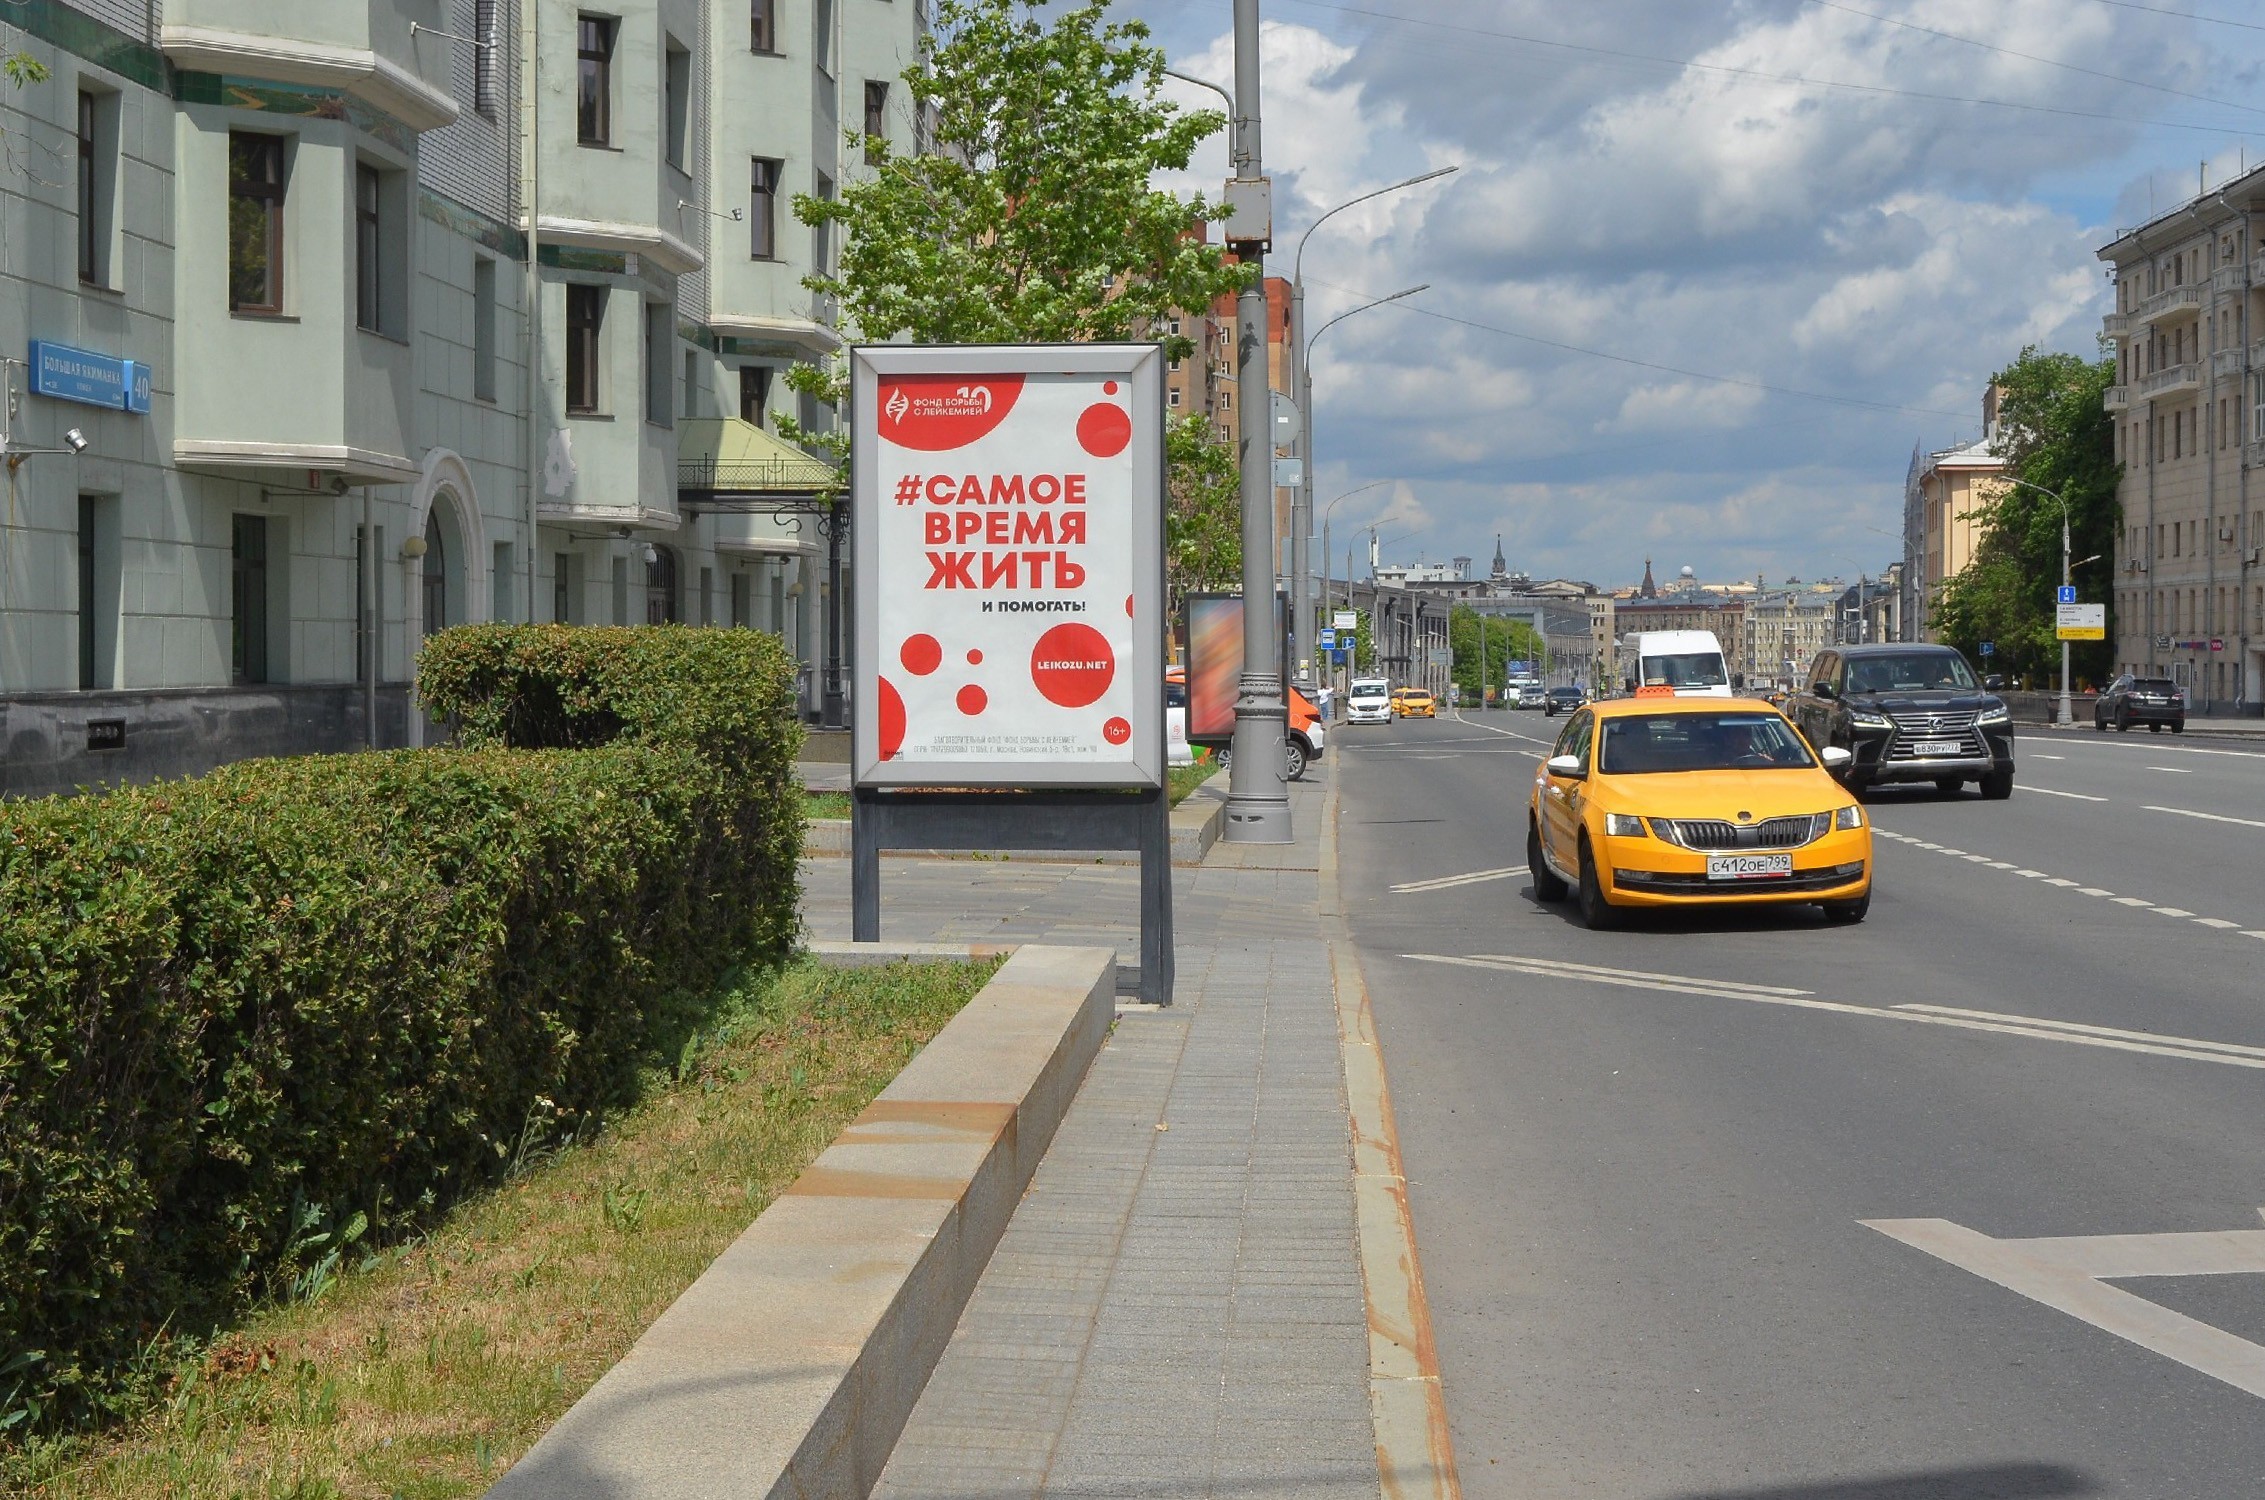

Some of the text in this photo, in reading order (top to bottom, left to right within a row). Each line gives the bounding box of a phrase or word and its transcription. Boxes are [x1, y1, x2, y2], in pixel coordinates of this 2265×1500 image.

[44, 355, 121, 386] БОЛЬШАЯ ЯКИМАНКА
[134, 375, 149, 400] 40
[913, 397, 983, 407] ФОНД БОРЬБЫ
[913, 405, 983, 416] С ЛЕЙКЕМИЕЙ
[894, 474, 1086, 505] #САМОЕ
[924, 511, 1086, 544] ВРЕМЯ
[923, 551, 1086, 589] ЖИТЬ
[981, 601, 1086, 612] И ПОМОГАТЬ!
[1037, 661, 1107, 670] LEIKOZU.NET
[1108, 726, 1126, 736] 16+
[1712, 856, 1788, 873] С412ОЕ 799
